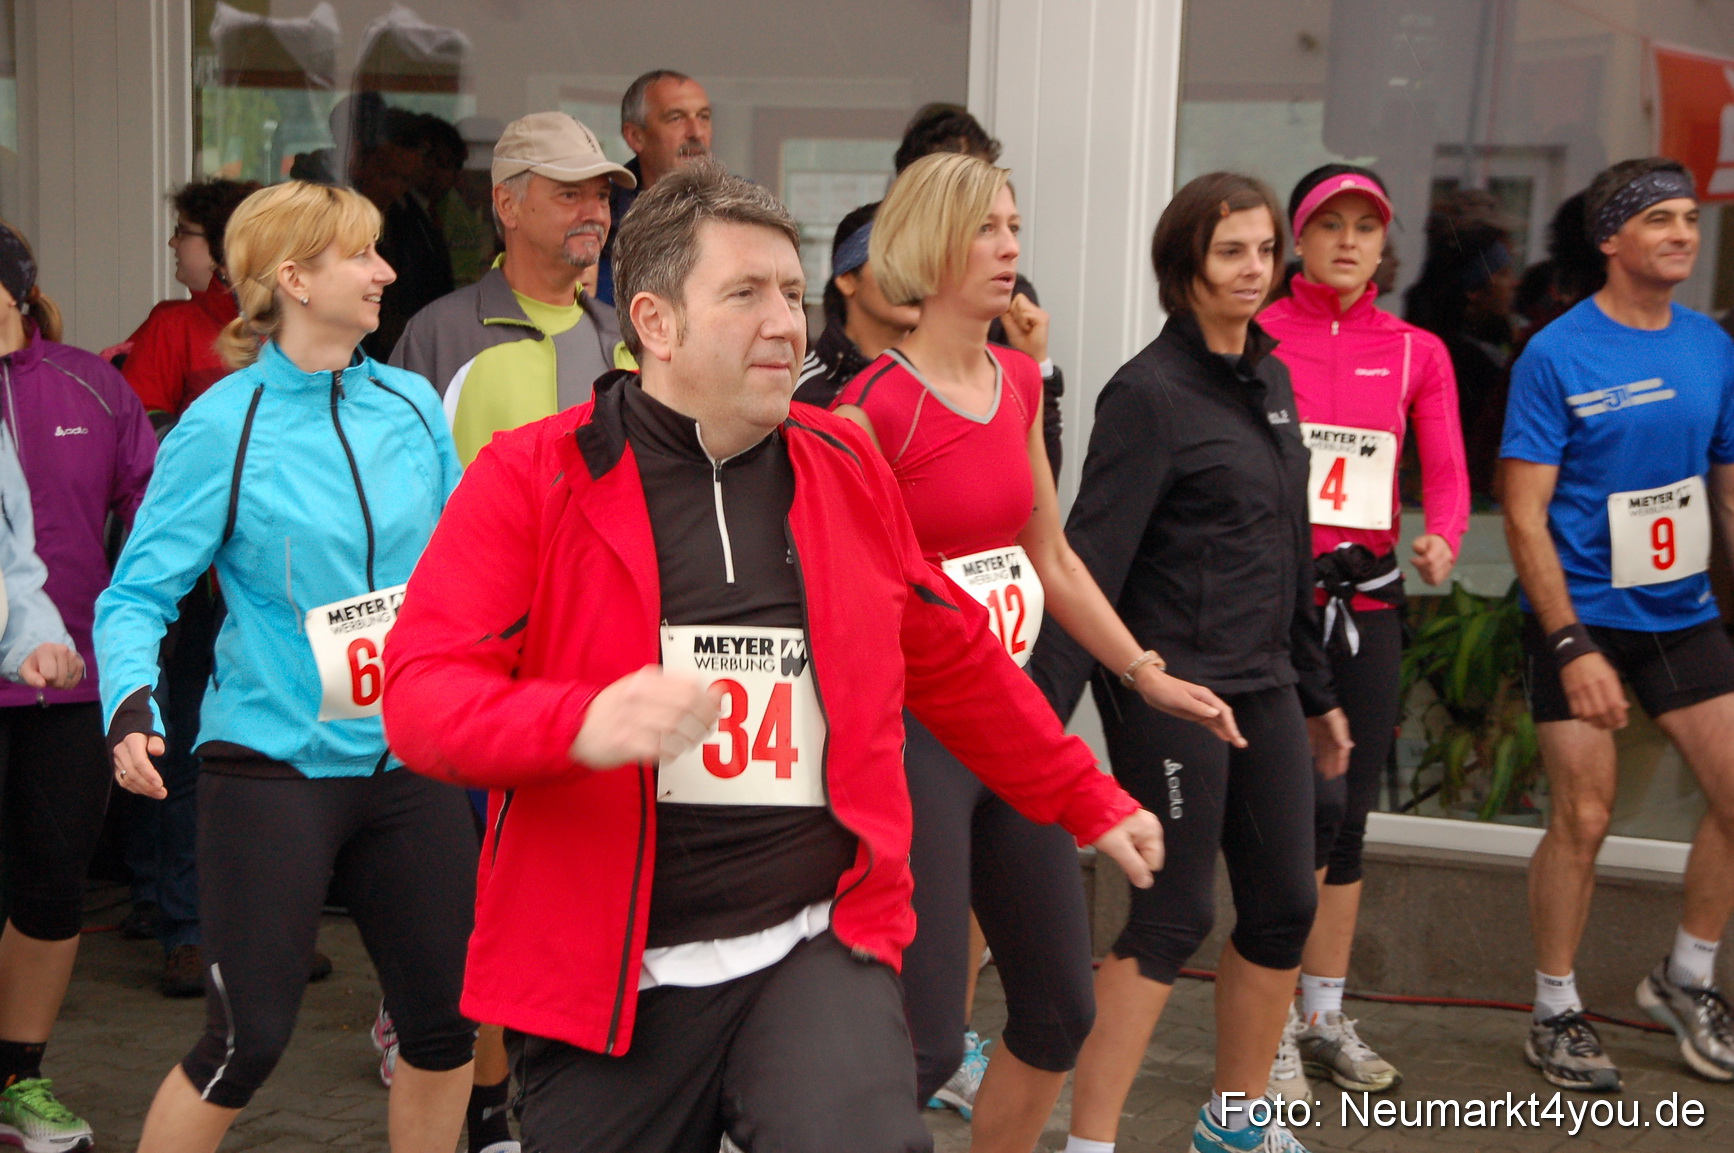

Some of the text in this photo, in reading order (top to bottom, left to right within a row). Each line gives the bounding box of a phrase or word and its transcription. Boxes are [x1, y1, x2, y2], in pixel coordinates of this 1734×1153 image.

[1310, 430, 1356, 444] MEYER
[1319, 457, 1347, 511] 4
[1628, 491, 1673, 508] MEYER
[1651, 517, 1675, 570] 9
[962, 556, 1005, 577] MEYER
[327, 598, 387, 626] MEYER
[986, 584, 1027, 655] 12
[693, 635, 774, 656] MEYER
[347, 629, 390, 706] 6
[693, 656, 775, 673] WERBUNG
[703, 678, 799, 779] 34
